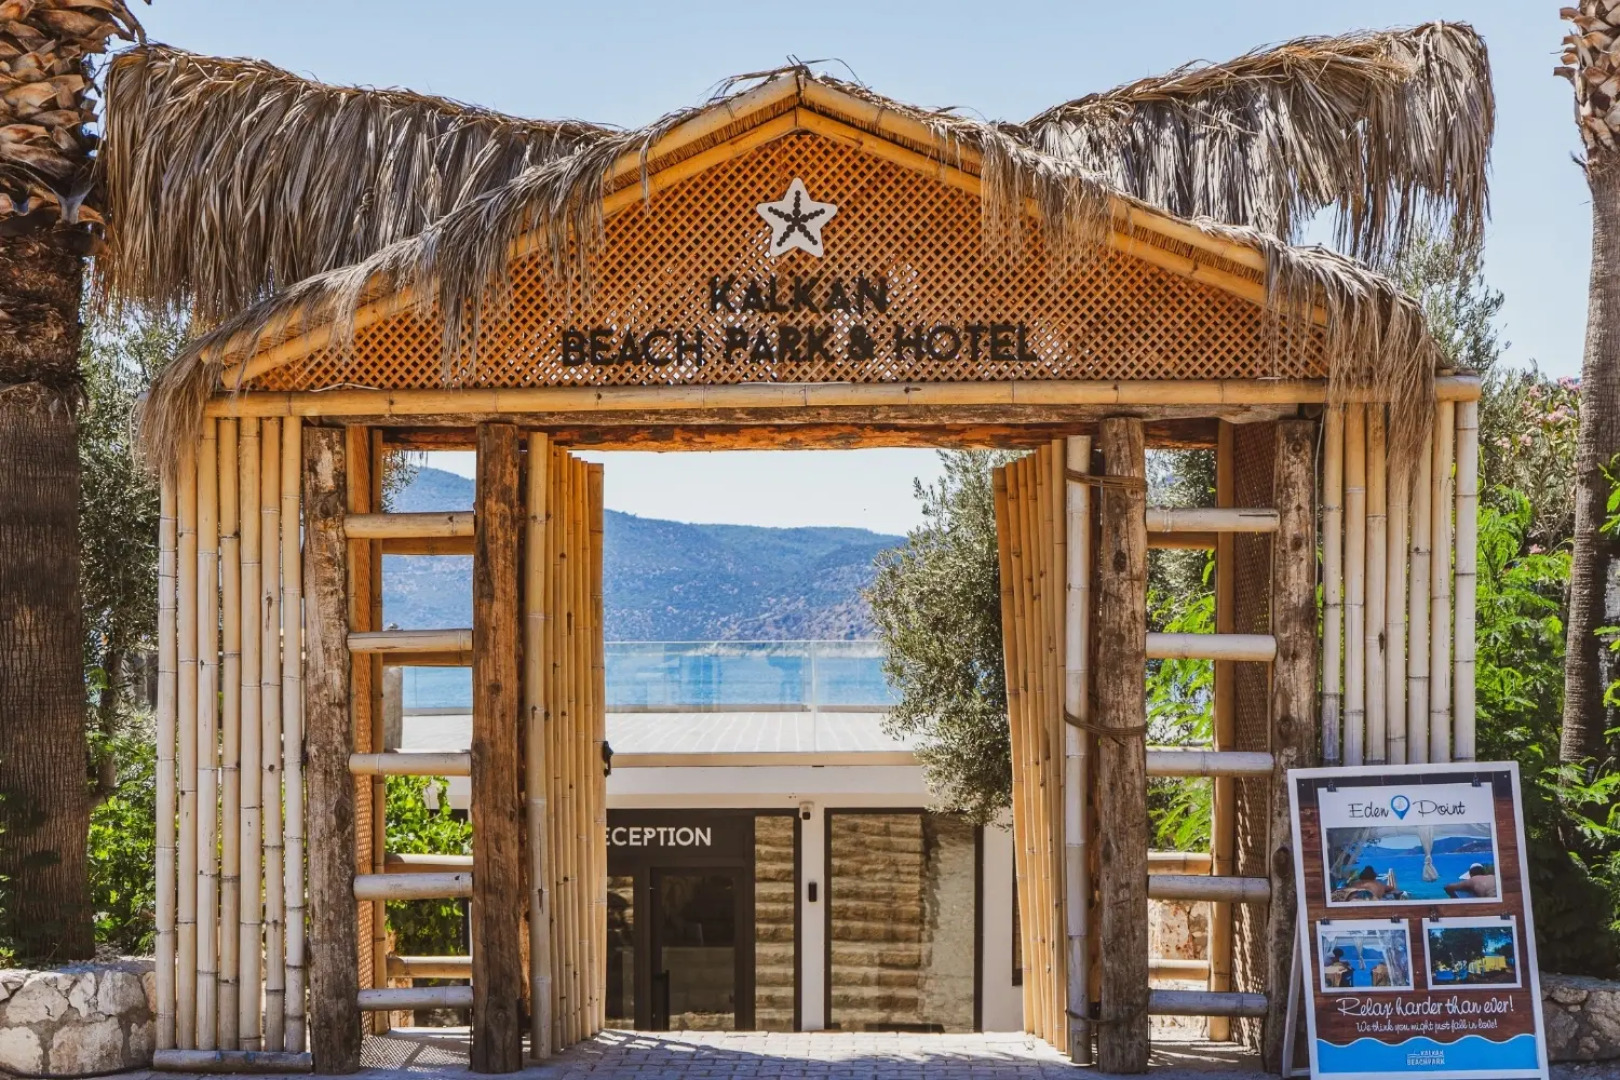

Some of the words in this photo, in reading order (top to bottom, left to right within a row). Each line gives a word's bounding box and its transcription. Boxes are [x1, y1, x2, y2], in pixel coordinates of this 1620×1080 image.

[708, 274, 887, 314] KALKAN
[561, 329, 702, 366] BEACH
[725, 325, 836, 363] PARK
[848, 324, 874, 362] &
[894, 322, 1037, 362] HOTEL
[1348, 801, 1389, 818] Eden
[1412, 800, 1466, 817] Point
[1336, 997, 1393, 1018] Relax
[1395, 996, 1442, 1016] harder
[1446, 995, 1482, 1014] than
[1484, 995, 1514, 1013] ever!
[1356, 1020, 1372, 1032] We
[1371, 1019, 1394, 1032] think
[1394, 1023, 1410, 1034] you
[1411, 1020, 1433, 1034] might
[1434, 1020, 1450, 1034] just
[1478, 1018, 1498, 1029] love!
